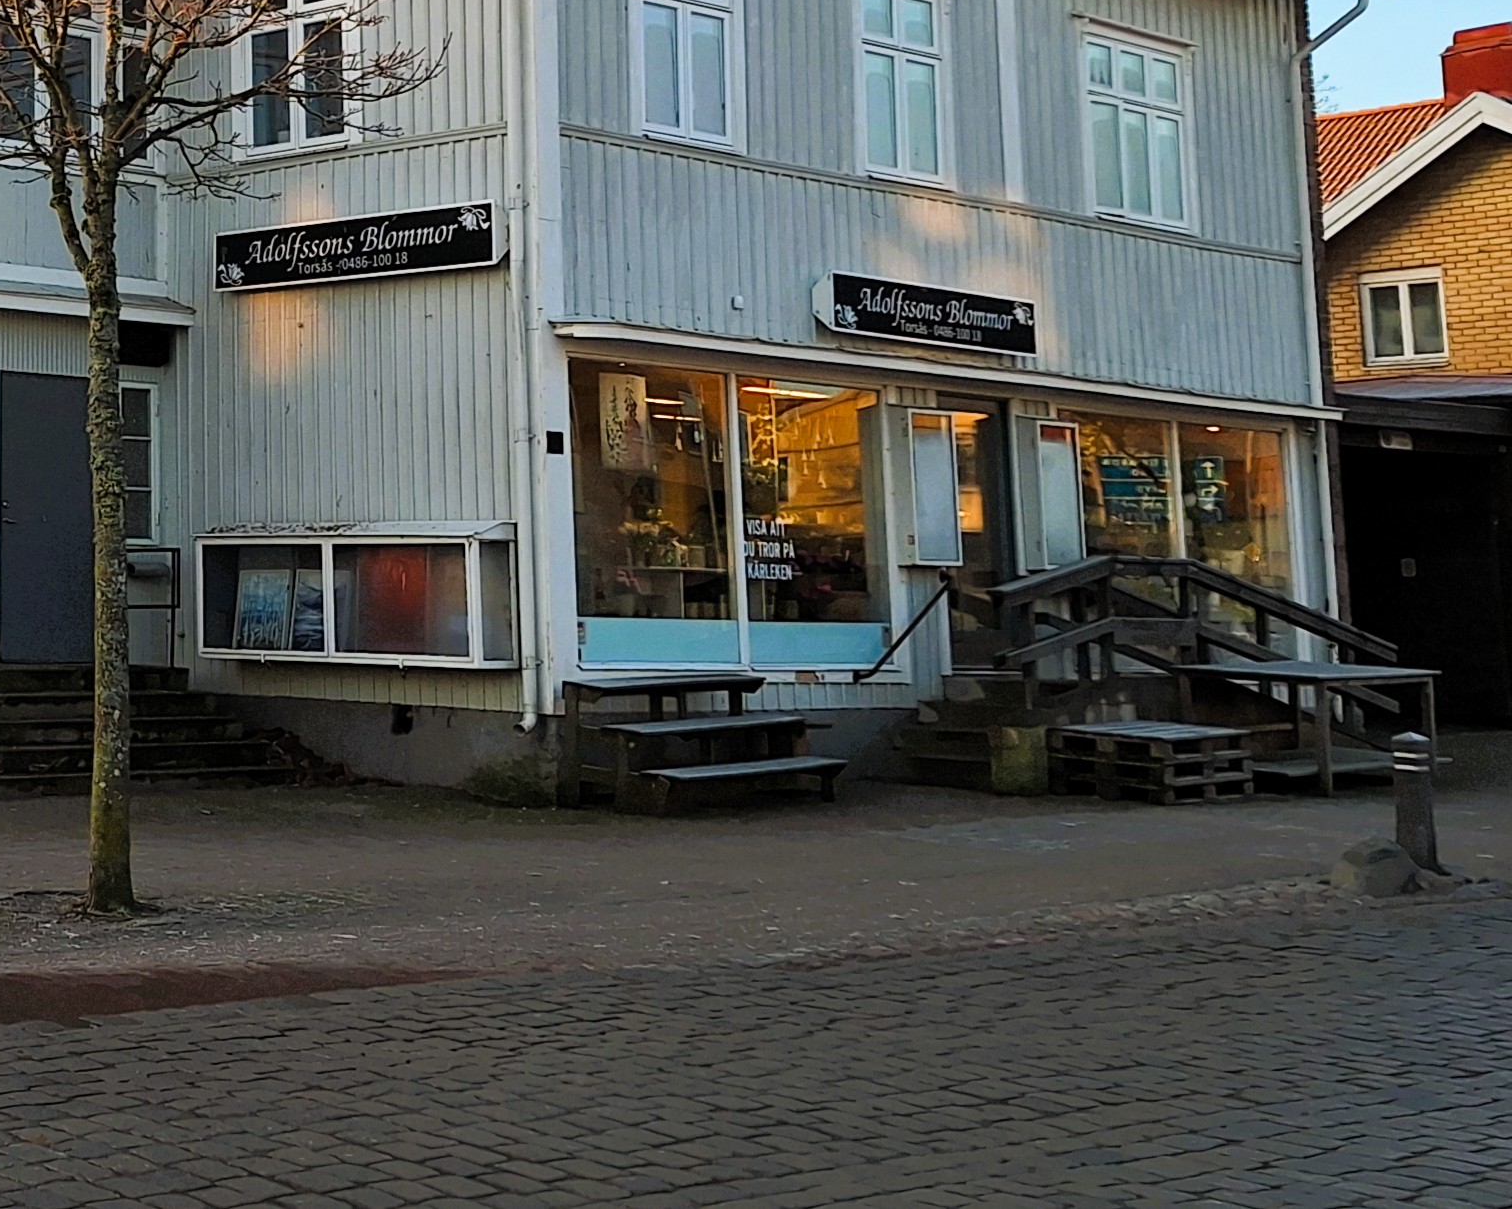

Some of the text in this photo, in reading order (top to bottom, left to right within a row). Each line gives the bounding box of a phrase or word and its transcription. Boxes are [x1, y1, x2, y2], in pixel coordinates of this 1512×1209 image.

[245, 221, 459, 272] Adolfssons Blommor
[297, 258, 333, 275] Torsås
[341, 253, 392, 270] 0486-100
[395, 251, 408, 265] 18
[857, 287, 1014, 331] Adolfssons Blommor
[746, 519, 785, 538] VISA ATT
[743, 539, 796, 559] DU TROR PÅ
[747, 559, 793, 581] KÄRLEKEN
